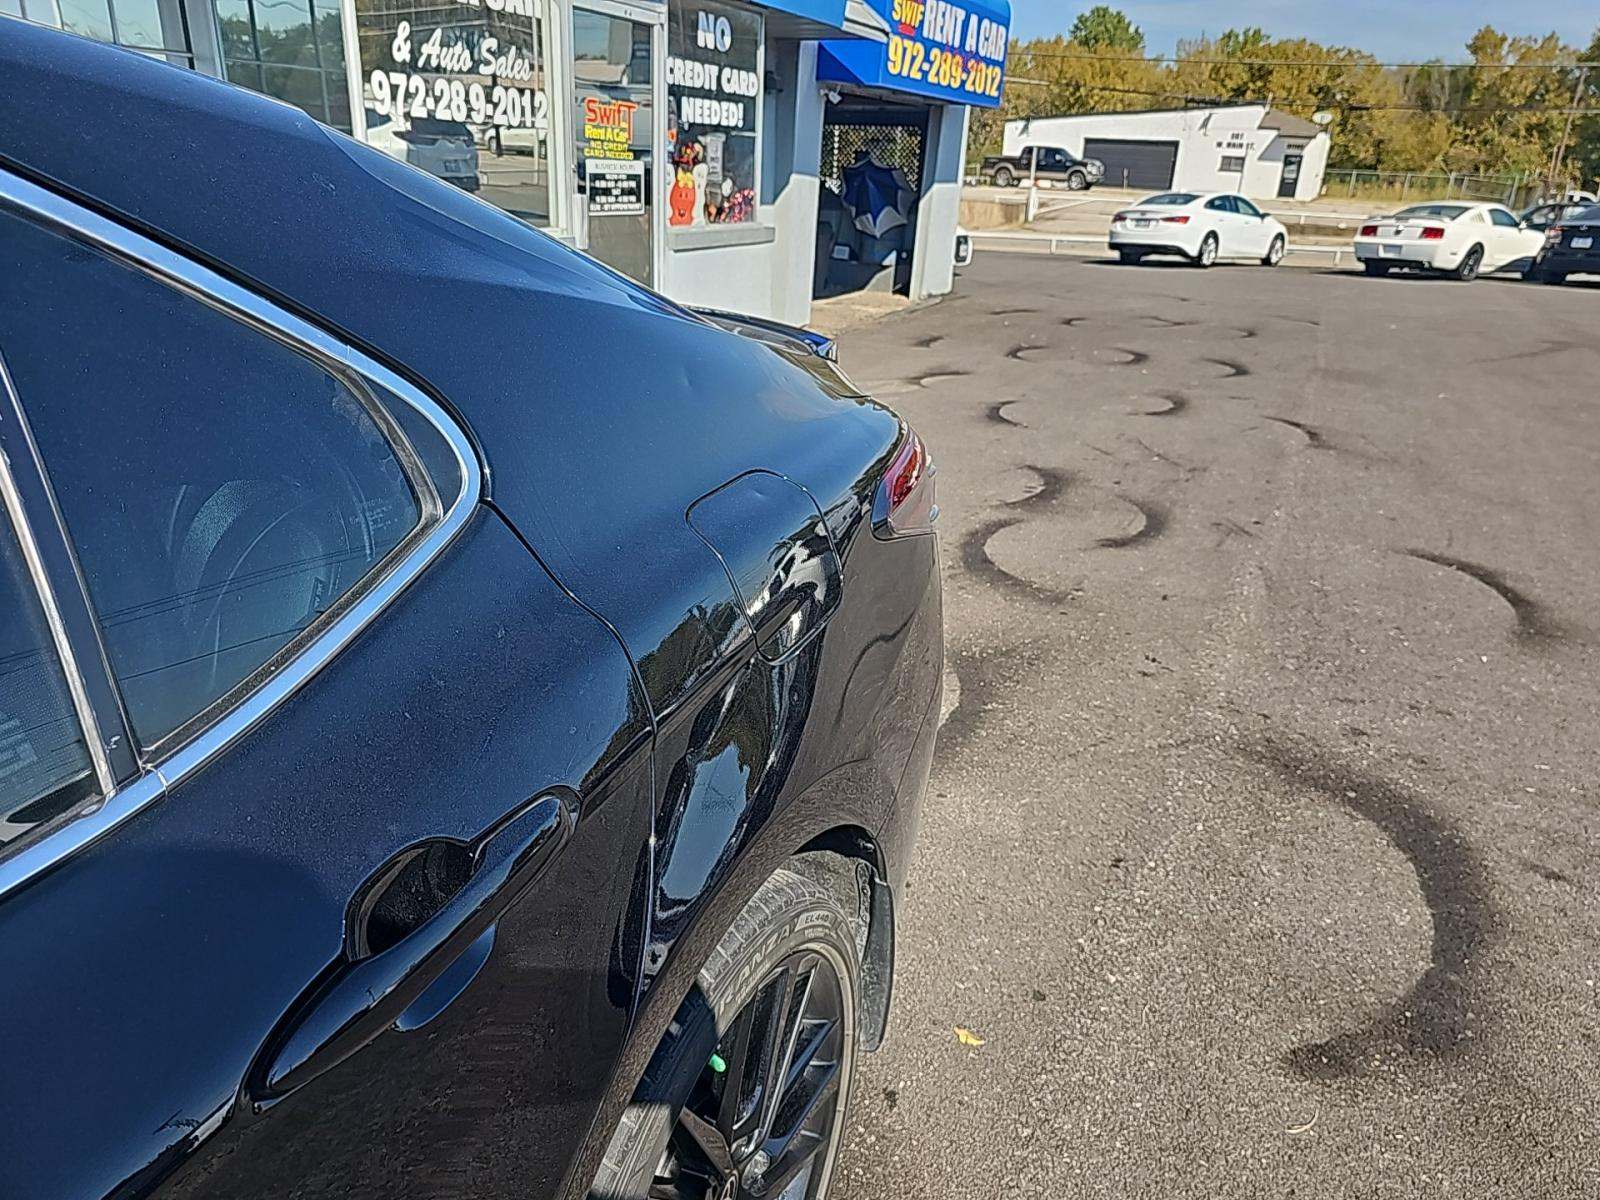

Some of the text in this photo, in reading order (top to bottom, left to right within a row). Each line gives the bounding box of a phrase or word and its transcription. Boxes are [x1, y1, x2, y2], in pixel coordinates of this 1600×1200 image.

[392, 20, 533, 82] & Auto Sales
[697, 10, 732, 52] NO
[922, 0, 966, 49] RENT
[964, 13, 979, 53] A
[977, 17, 1007, 63] CAR
[665, 56, 759, 97] CREDIT CARD
[887, 33, 1002, 98] 972-289-2012
[370, 69, 549, 130] 972-289-2012
[681, 96, 744, 128] NEEDED!
